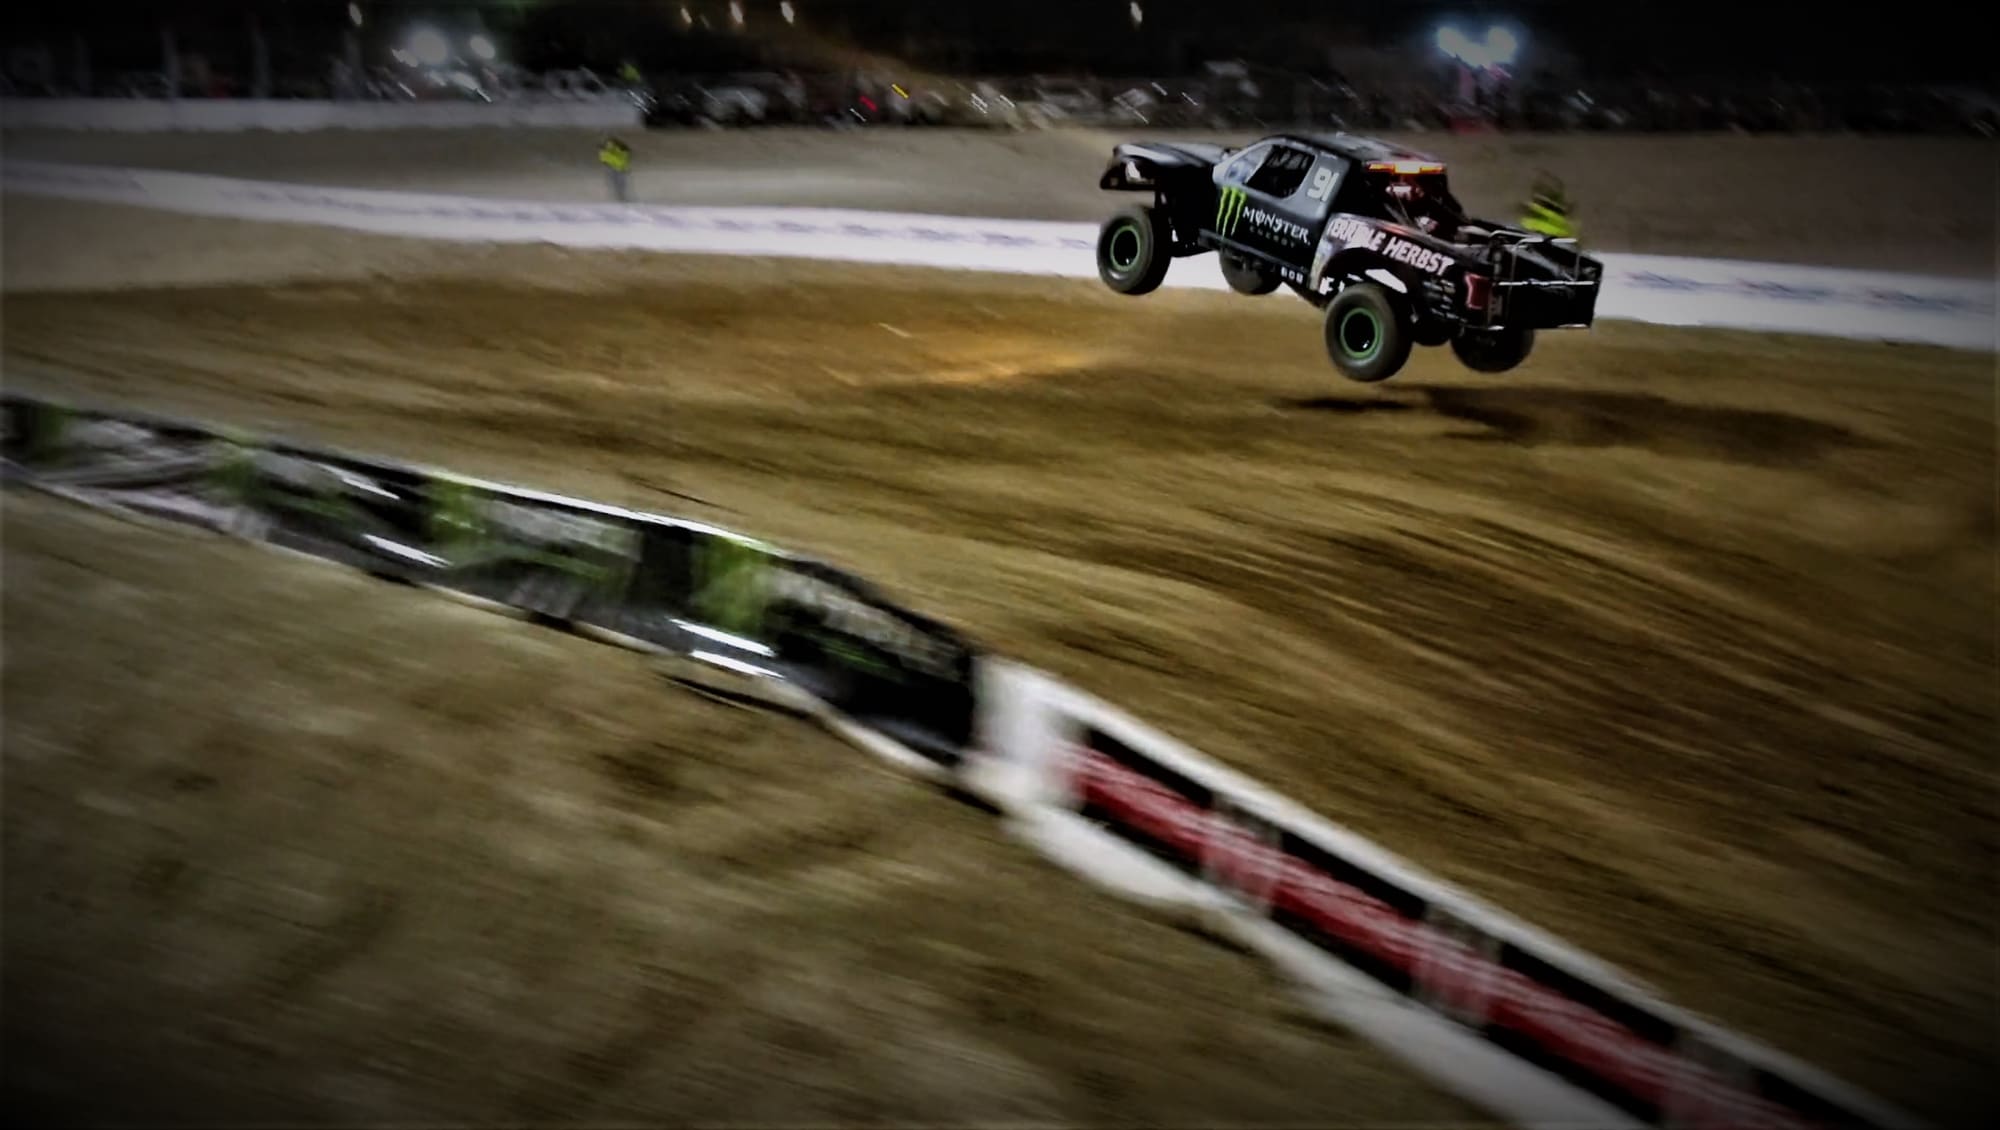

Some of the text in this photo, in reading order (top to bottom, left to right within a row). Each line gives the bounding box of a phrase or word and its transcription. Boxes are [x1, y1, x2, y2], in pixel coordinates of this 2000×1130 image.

[1307, 167, 1340, 202] 91
[1242, 206, 1309, 244] MONSTER
[1325, 217, 1455, 276] TERRLE HERBST
